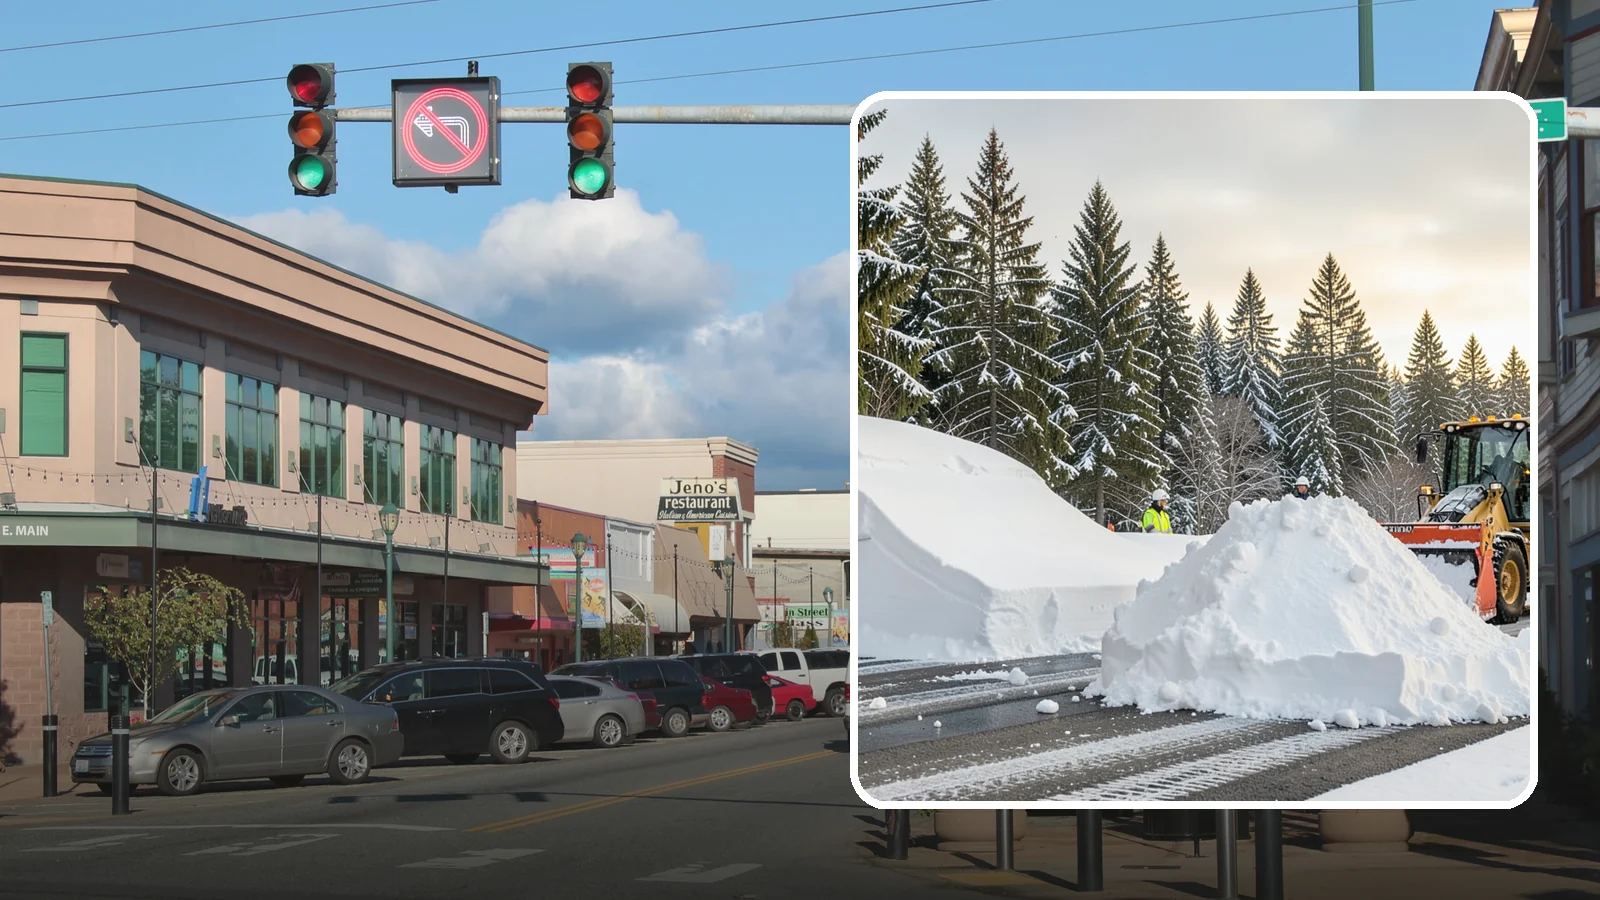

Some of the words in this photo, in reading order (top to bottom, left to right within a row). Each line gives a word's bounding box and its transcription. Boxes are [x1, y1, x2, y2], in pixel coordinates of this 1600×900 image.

[670, 480, 728, 495] Jeno's
[665, 496, 731, 509] restaurant
[658, 509, 681, 519] Italian
[686, 509, 714, 519] American
[715, 509, 738, 519] Cuisine
[2, 525, 13, 536] E.
[15, 525, 49, 536] MAIN
[797, 607, 828, 617] Street
